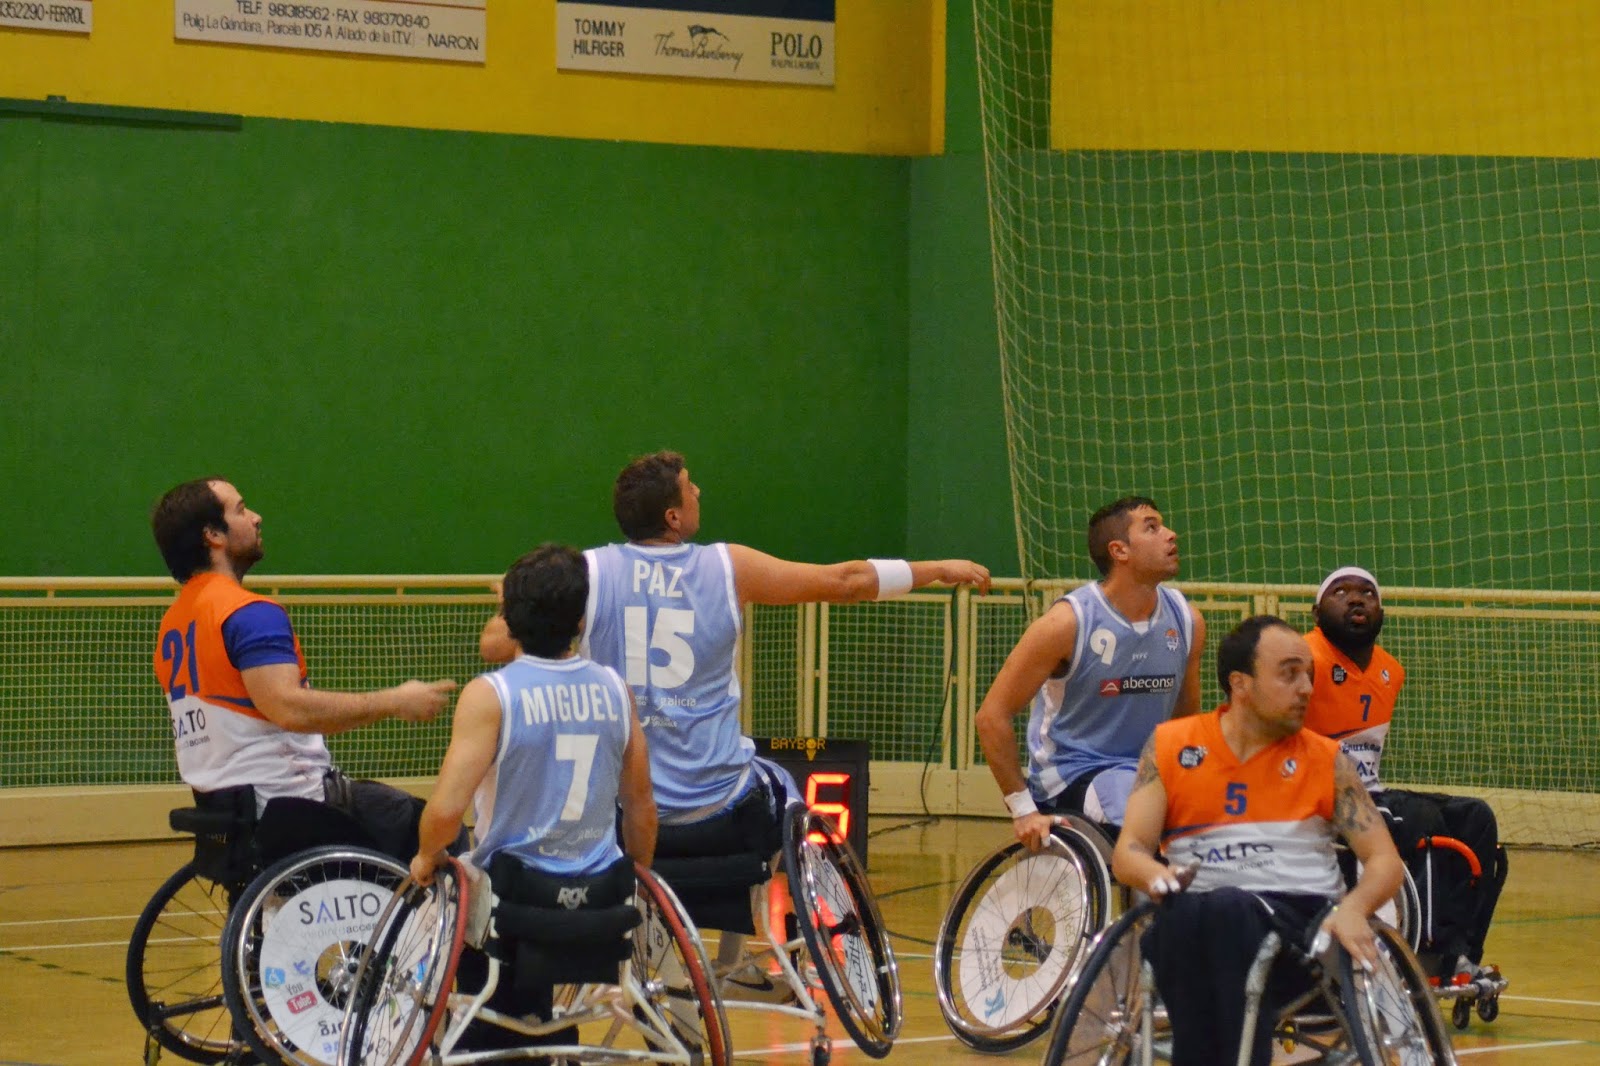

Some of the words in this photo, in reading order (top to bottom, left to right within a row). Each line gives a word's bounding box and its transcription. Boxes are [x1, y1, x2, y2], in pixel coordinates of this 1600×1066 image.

[336, 9, 358, 23] FAX
[574, 18, 626, 37] TOMMY
[428, 33, 479, 51] NARON
[573, 39, 625, 57] HILFIGER
[770, 31, 823, 59] POLO
[633, 558, 684, 599] PAZ
[161, 619, 200, 701] 21
[624, 605, 696, 690] 15
[1089, 628, 1117, 666] 9
[1122, 676, 1174, 689] abeconsa
[520, 683, 620, 726] MIGUEL
[1359, 694, 1372, 721] 7
[553, 733, 600, 821] 7
[805, 772, 851, 844] 5
[1224, 781, 1248, 815] 5
[299, 892, 381, 925] SALTO
[285, 982, 304, 996] You
